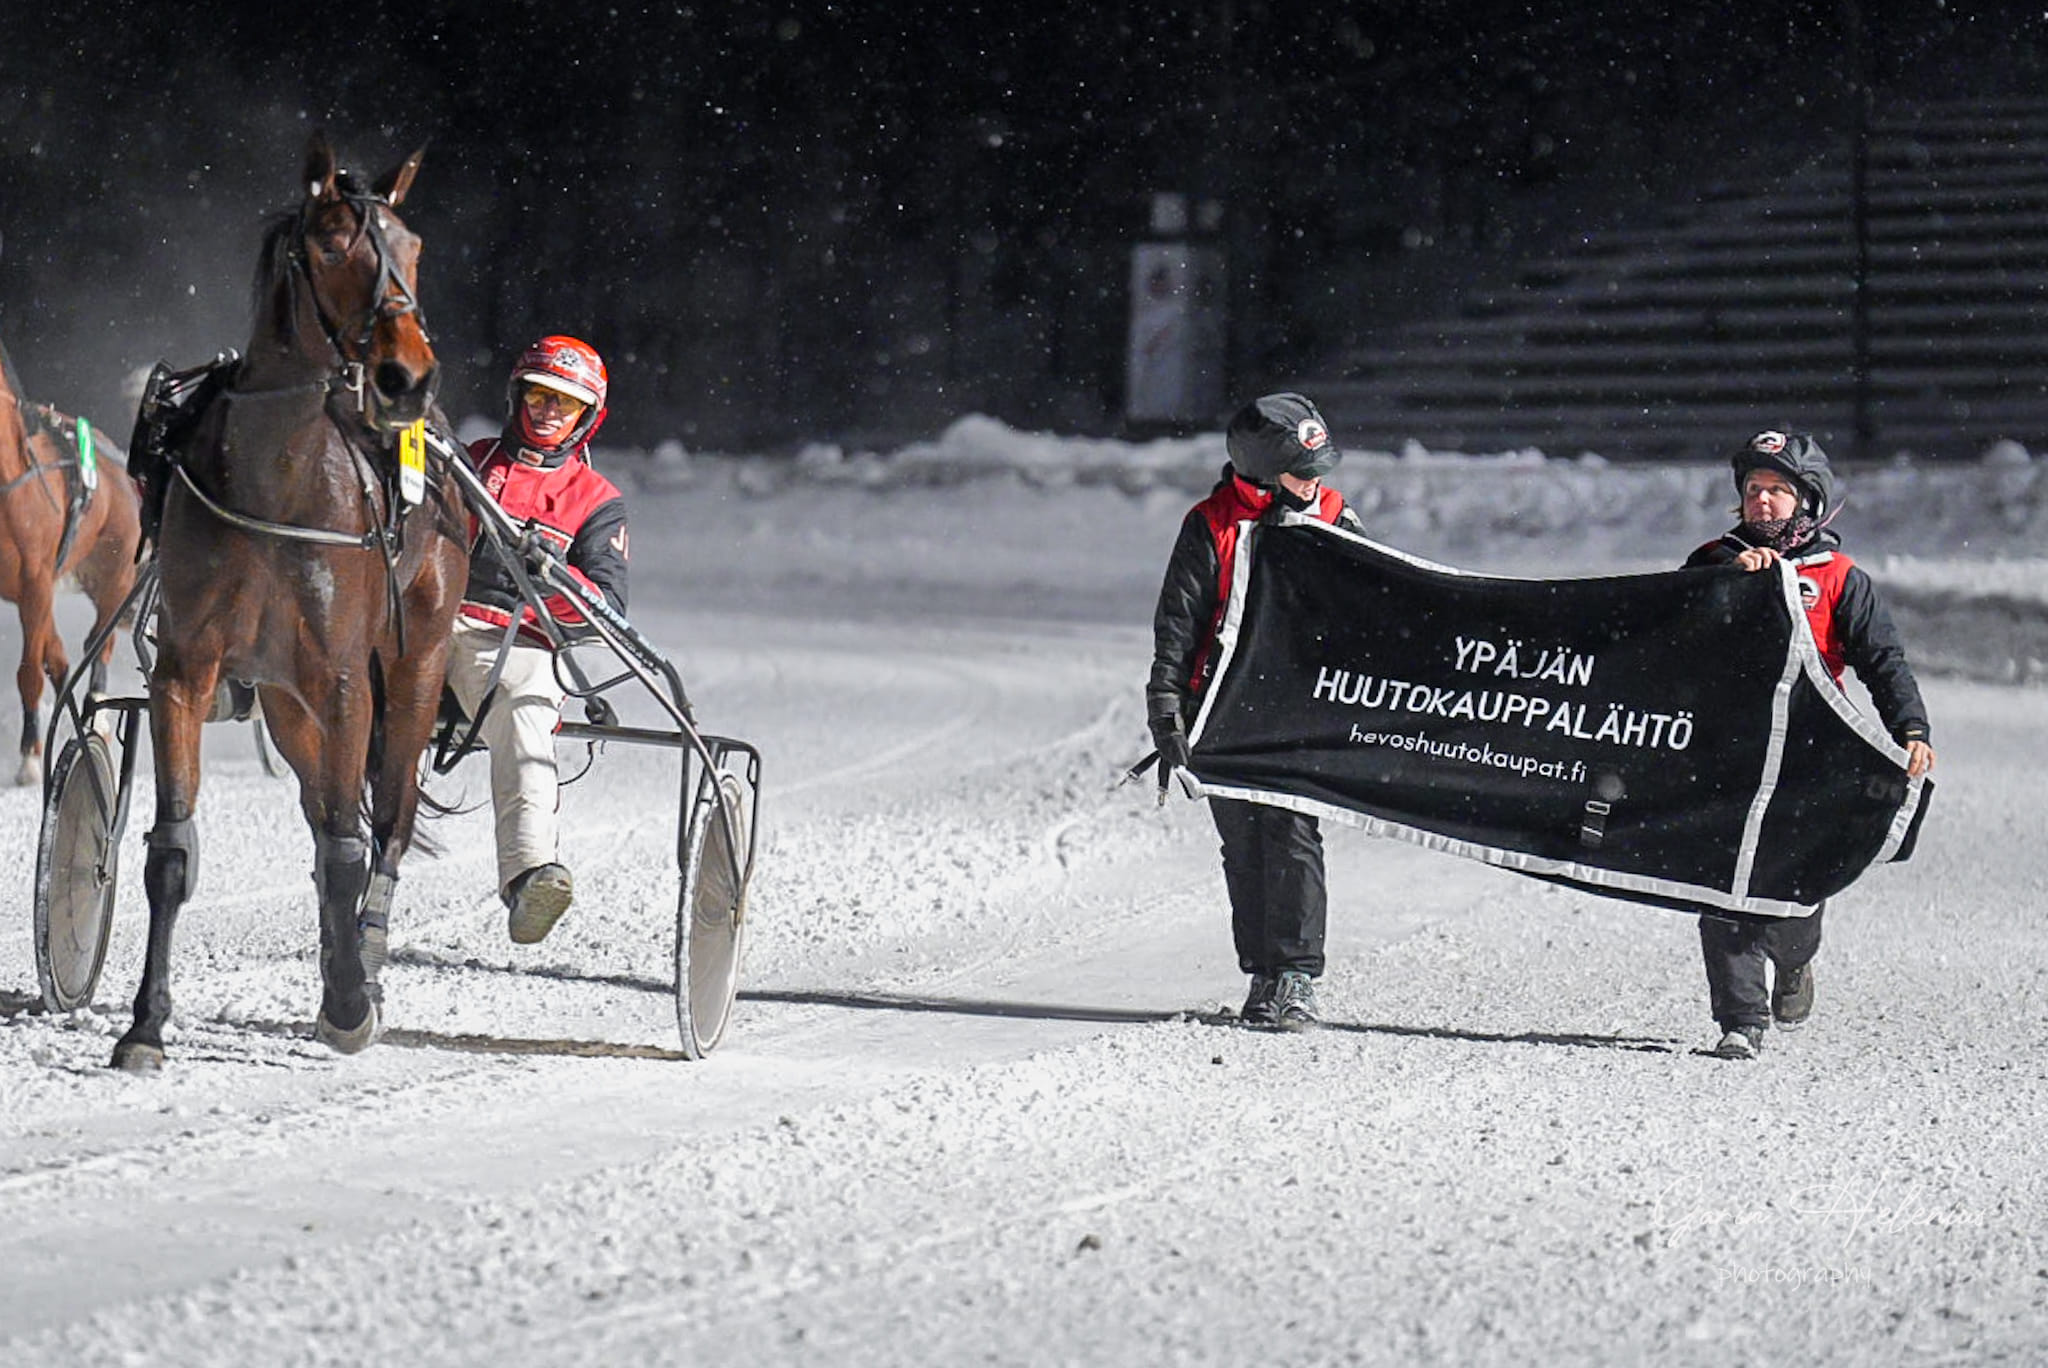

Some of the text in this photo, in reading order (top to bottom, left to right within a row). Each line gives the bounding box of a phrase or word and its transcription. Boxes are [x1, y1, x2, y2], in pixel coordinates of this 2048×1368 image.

[1454, 635, 1595, 687] YPÄJÄN
[1312, 666, 1694, 751] HUUTOKAUPPALÄHTÖ
[1348, 723, 1587, 783] hevoshuutokaupat.fi
